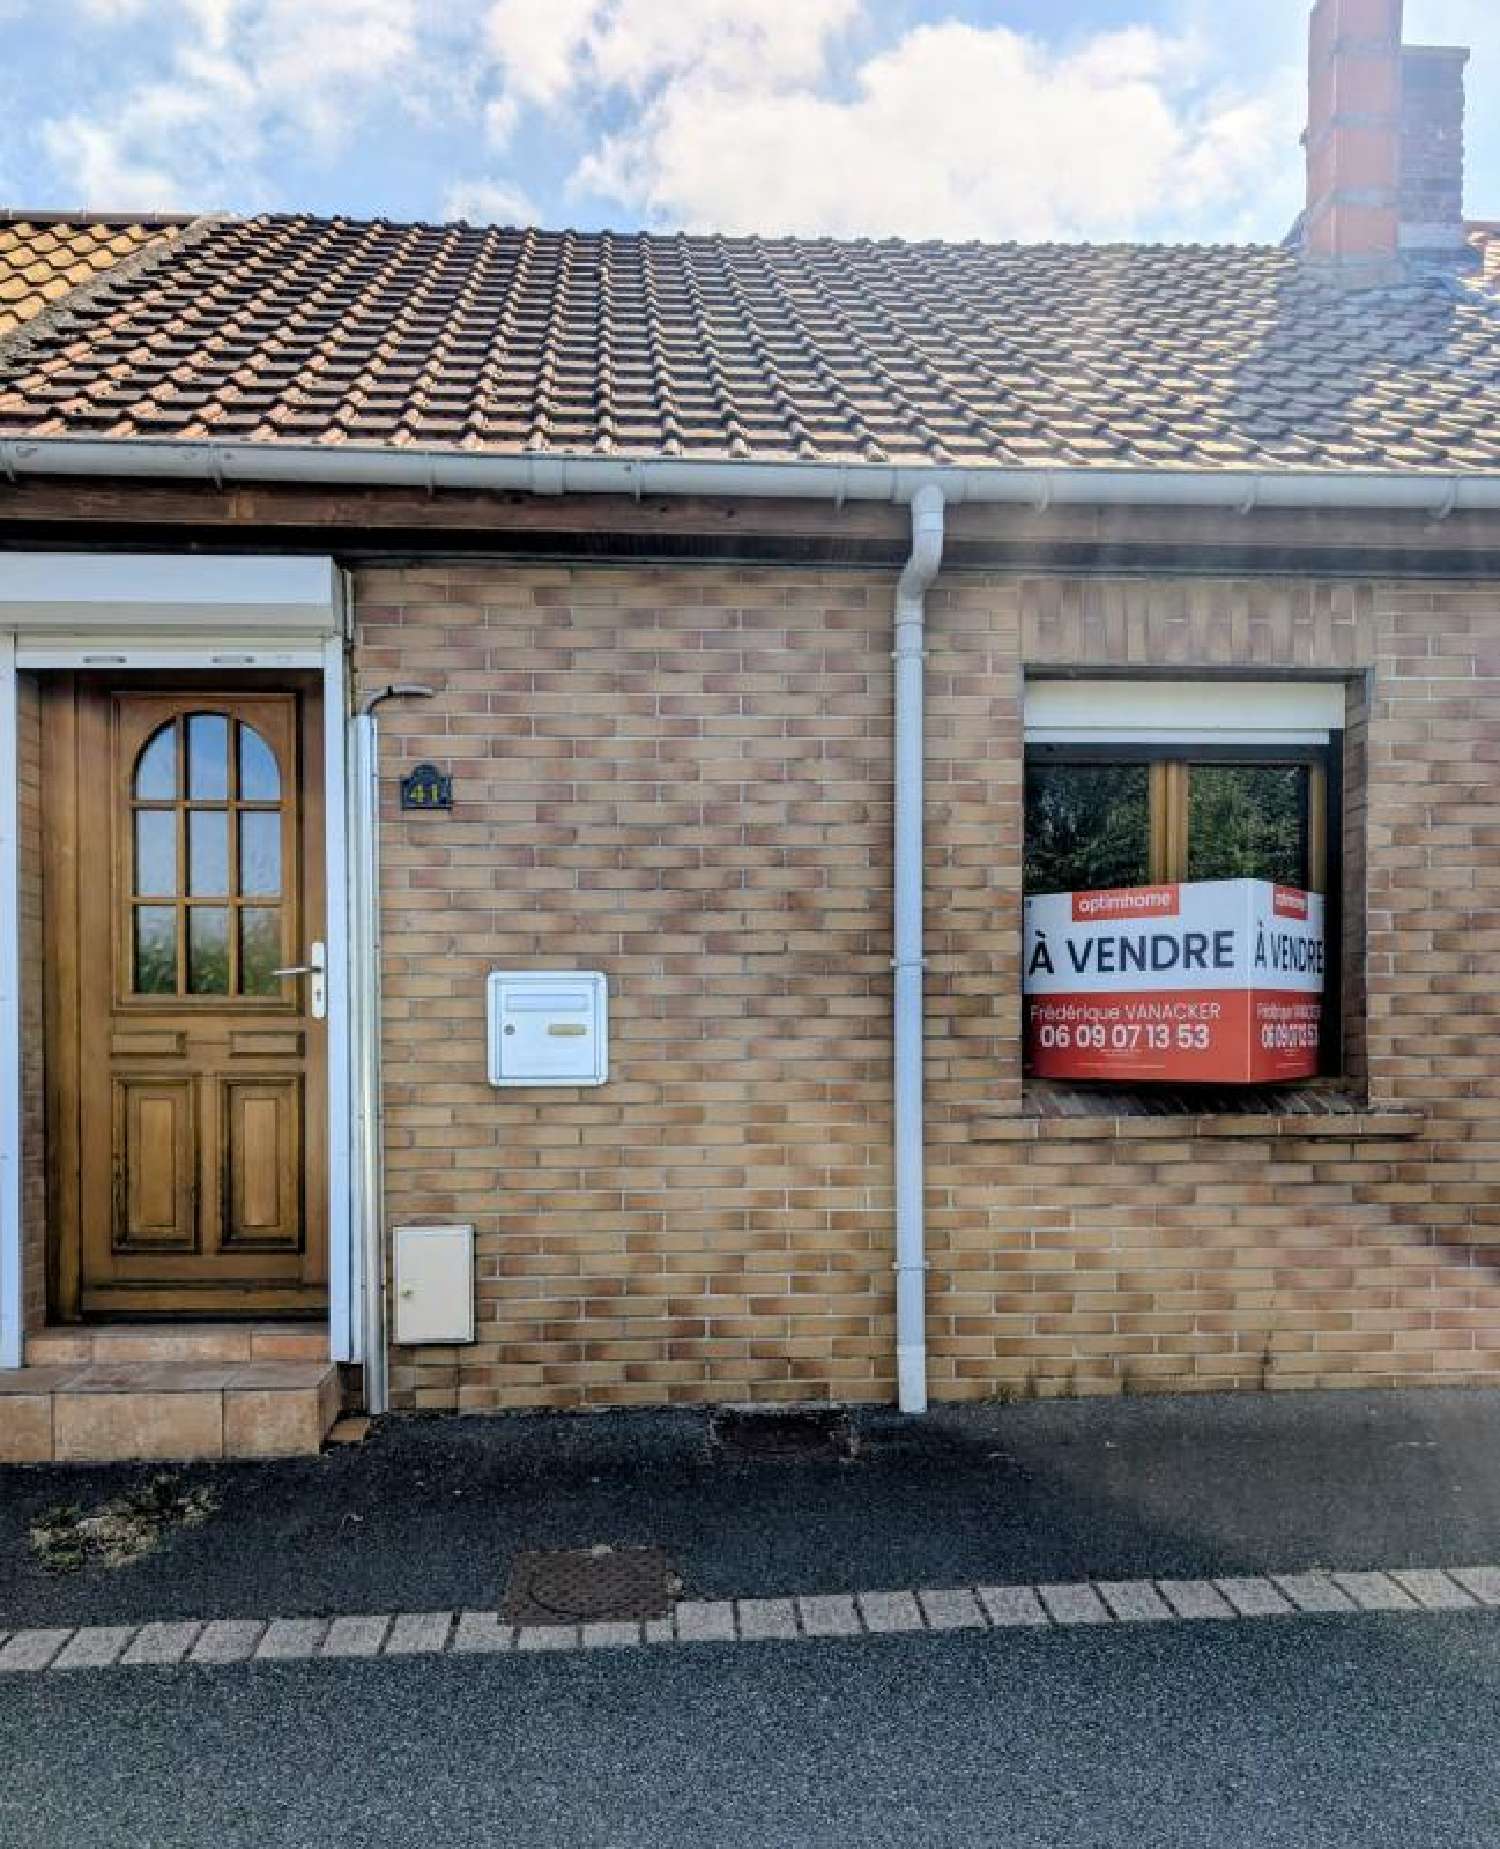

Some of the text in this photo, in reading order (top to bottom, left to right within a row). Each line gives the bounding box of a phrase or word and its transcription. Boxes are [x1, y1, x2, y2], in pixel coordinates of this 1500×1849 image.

[409, 783, 438, 803] 41
[1078, 892, 1170, 914] optimhome
[1028, 929, 1235, 976] À VENDRE
[1254, 919, 1324, 974] À VENDRE
[1030, 1002, 1221, 1024] Frédérique VANACKER
[1040, 1023, 1211, 1048] 06 09 07 13 53
